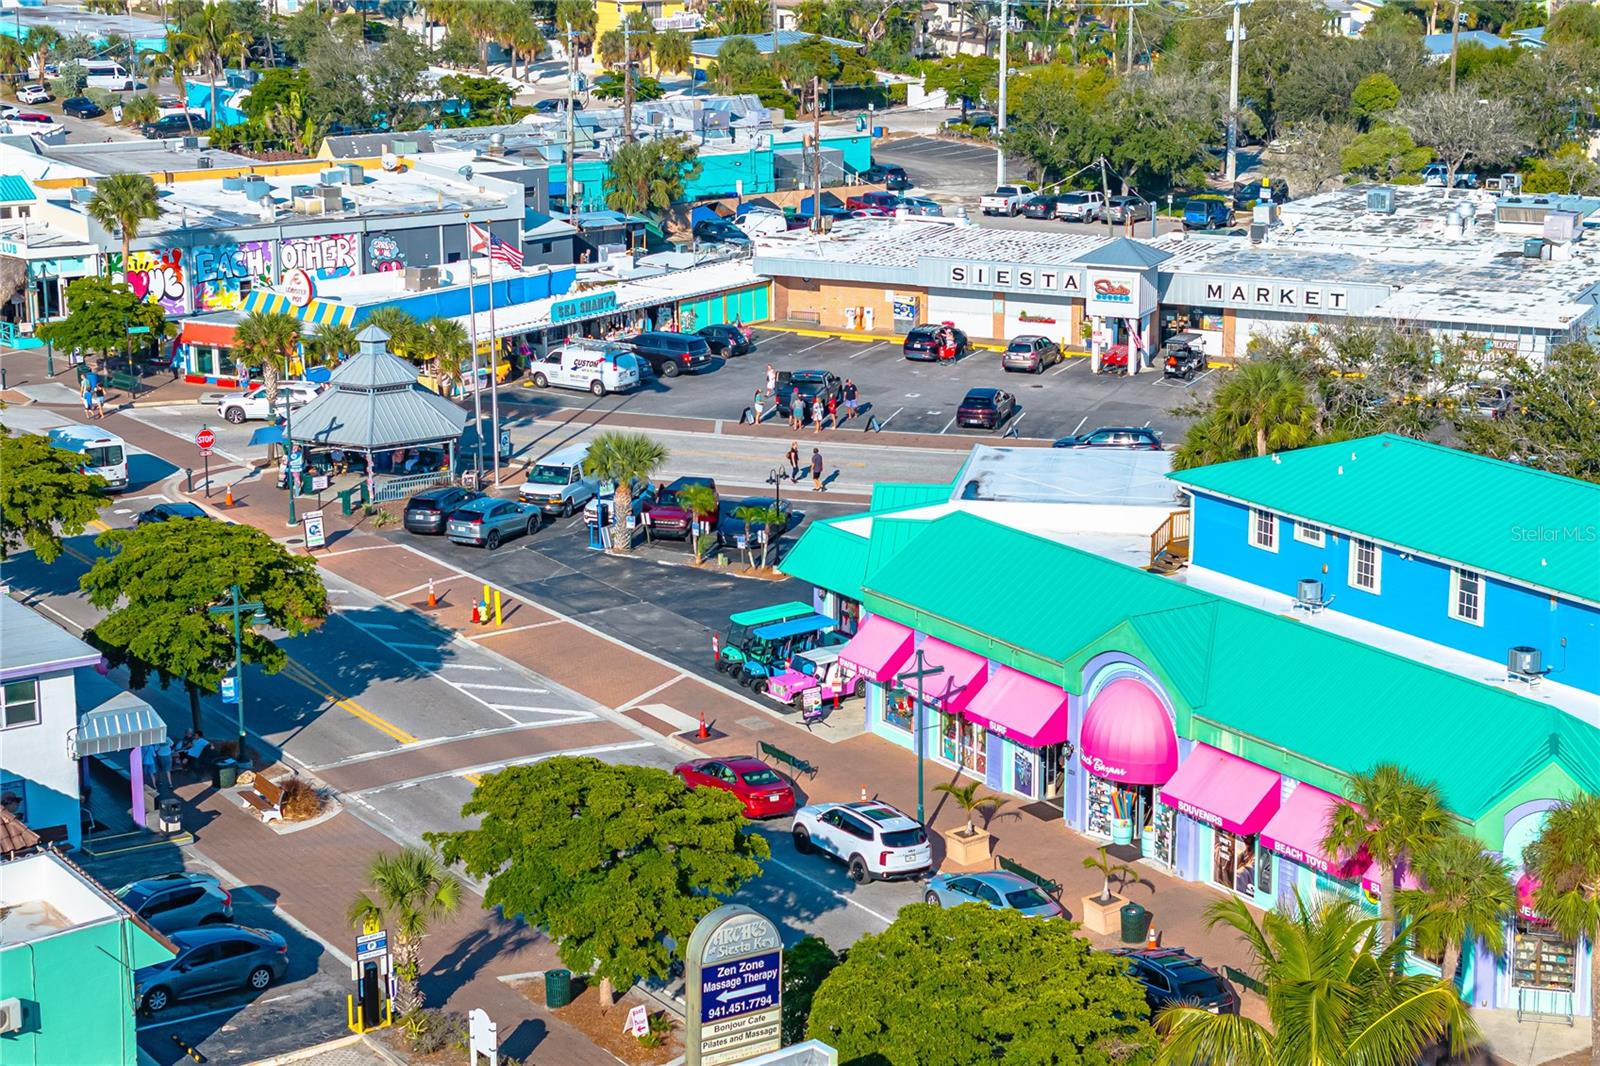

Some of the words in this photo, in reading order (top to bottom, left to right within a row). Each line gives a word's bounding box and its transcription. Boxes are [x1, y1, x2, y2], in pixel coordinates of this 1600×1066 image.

[0, 241, 18, 254] LUB
[281, 236, 355, 270] OTHER
[196, 248, 266, 284] EACH
[952, 267, 1079, 290] SIESTA
[1207, 284, 1345, 308] MARKET
[558, 304, 577, 318] SEA
[573, 358, 600, 368] CUSTOM
[197, 434, 214, 444] STOP
[988, 720, 1008, 736] SURF
[1177, 800, 1223, 827] SOUVENIRS
[1274, 841, 1303, 861] BEACH
[1305, 855, 1328, 871] TOYS
[713, 921, 767, 945] ARCHES
[717, 942, 750, 959] Siesta
[753, 936, 775, 952] Key
[717, 966, 737, 978] Zen
[739, 959, 765, 973] Zone
[703, 976, 742, 993] Massage
[743, 968, 778, 984] Therapy
[708, 995, 772, 1019] 941.451.7794
[714, 1018, 747, 1033] Bonjour
[748, 1014, 767, 1025] Cafe
[702, 1036, 728, 1050] Pilates
[729, 1032, 744, 1042] and
[745, 1025, 778, 1039] Massage
